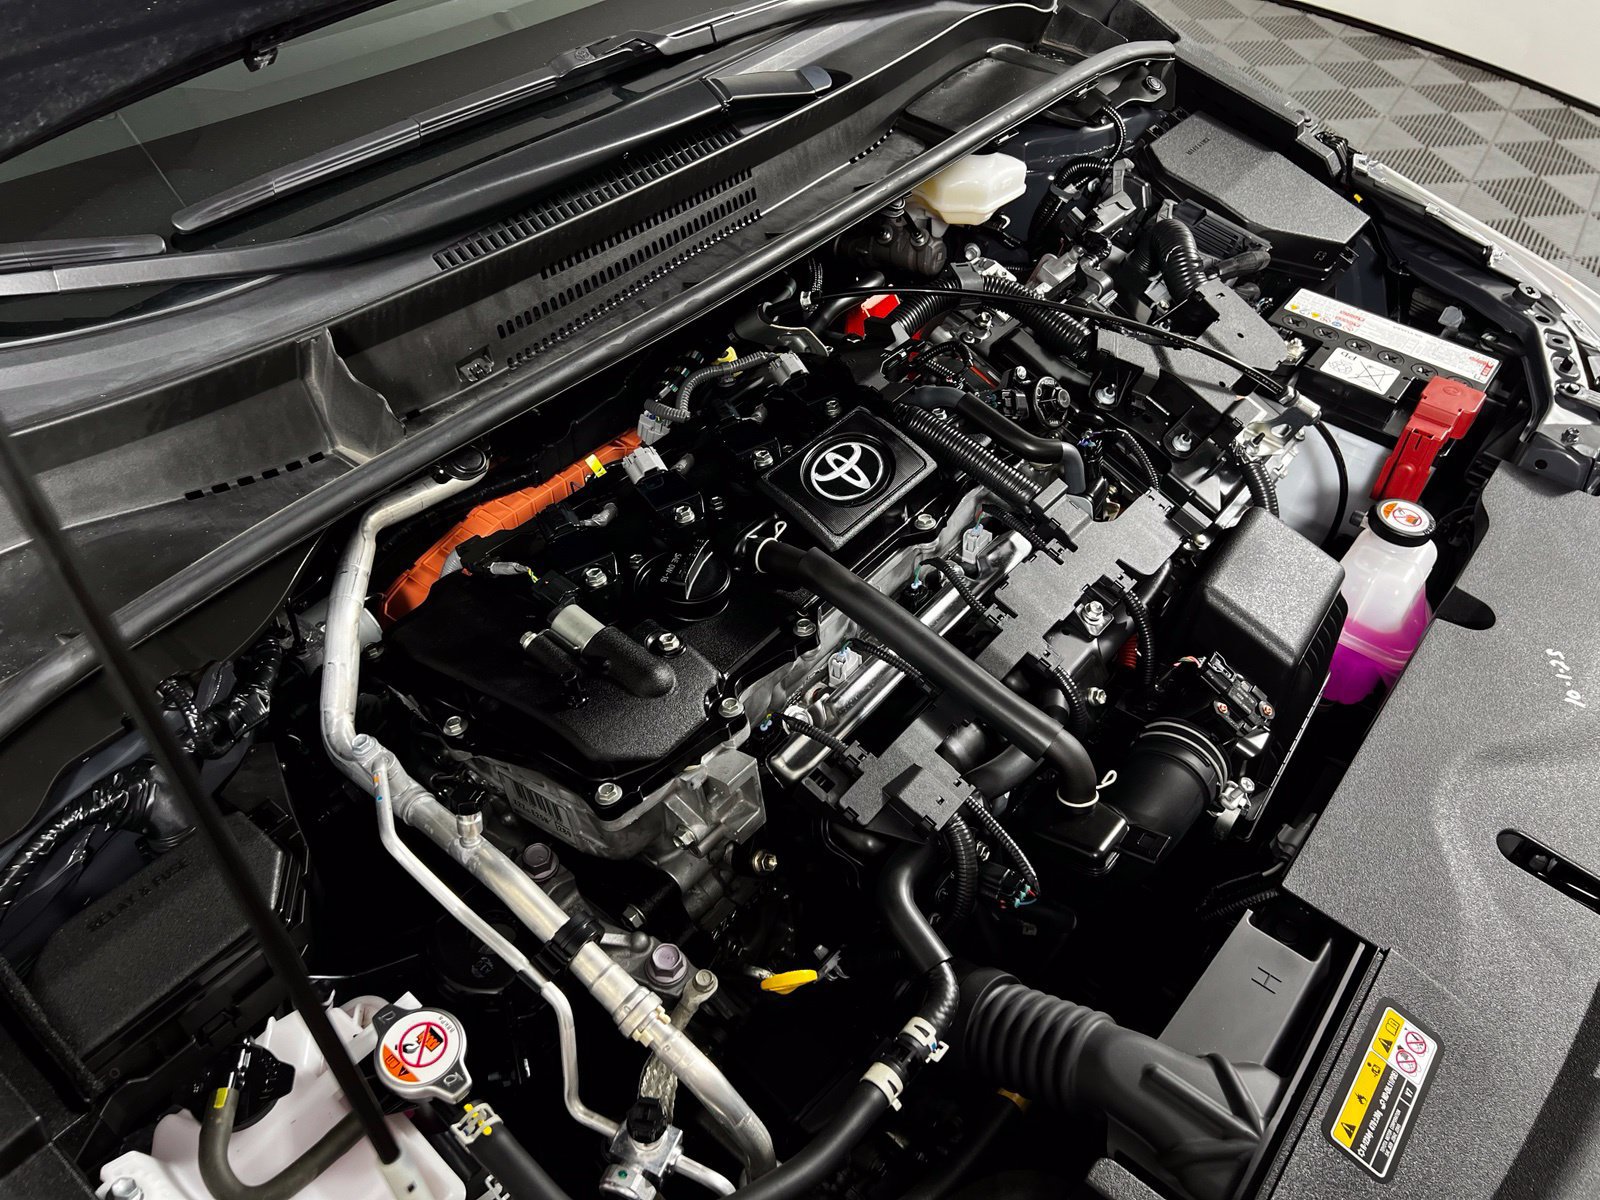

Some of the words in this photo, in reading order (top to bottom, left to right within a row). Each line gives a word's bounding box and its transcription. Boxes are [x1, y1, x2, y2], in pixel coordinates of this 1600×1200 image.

[1340, 351, 1359, 361] Pb
[151, 856, 192, 887] FUSE
[1251, 966, 1282, 995] H
